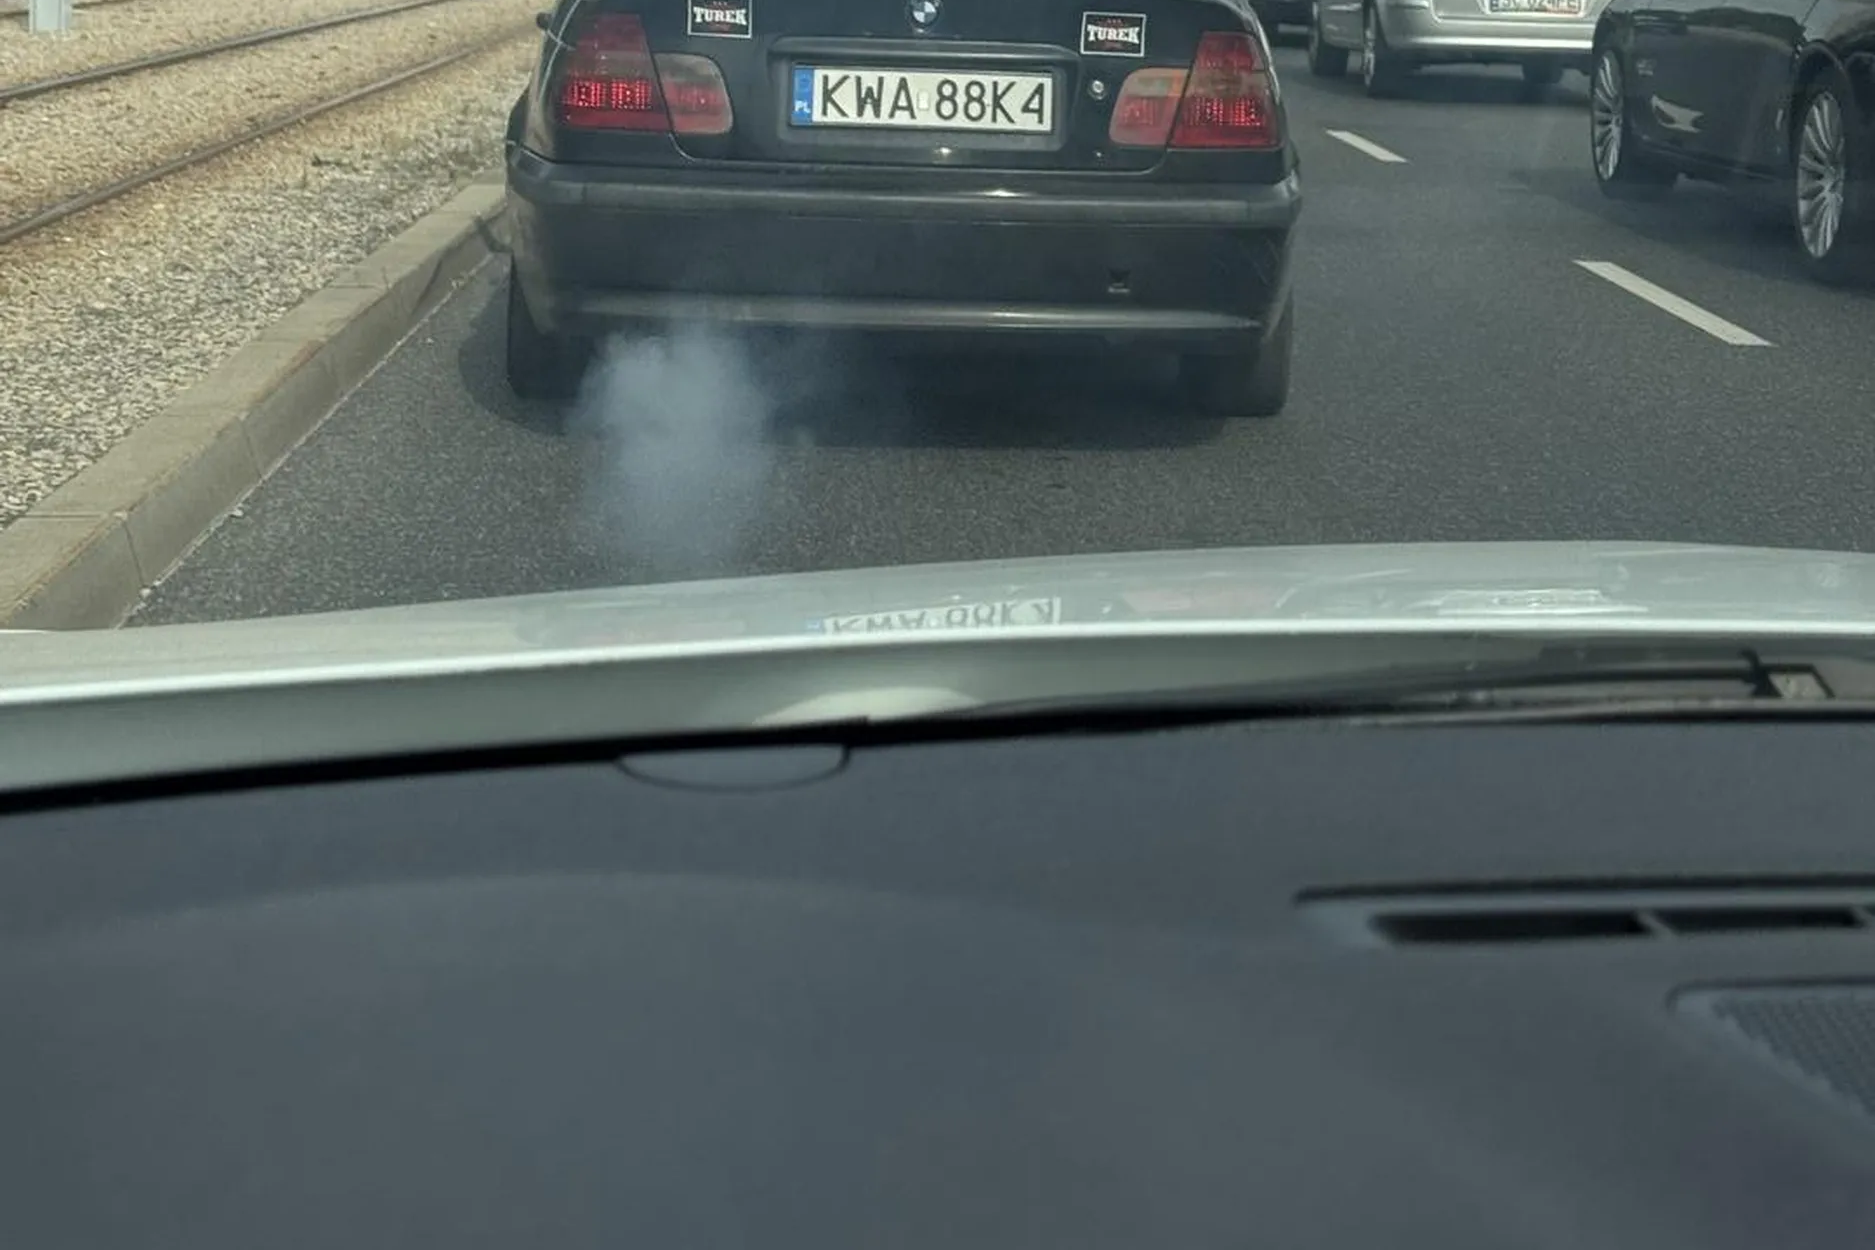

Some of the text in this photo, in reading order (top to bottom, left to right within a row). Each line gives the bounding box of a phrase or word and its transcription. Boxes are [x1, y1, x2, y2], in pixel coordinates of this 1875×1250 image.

[693, 6, 747, 26] TUREK
[1086, 24, 1140, 45] TUREK
[794, 100, 811, 113] PL
[821, 74, 1045, 125] KWA 88K4
